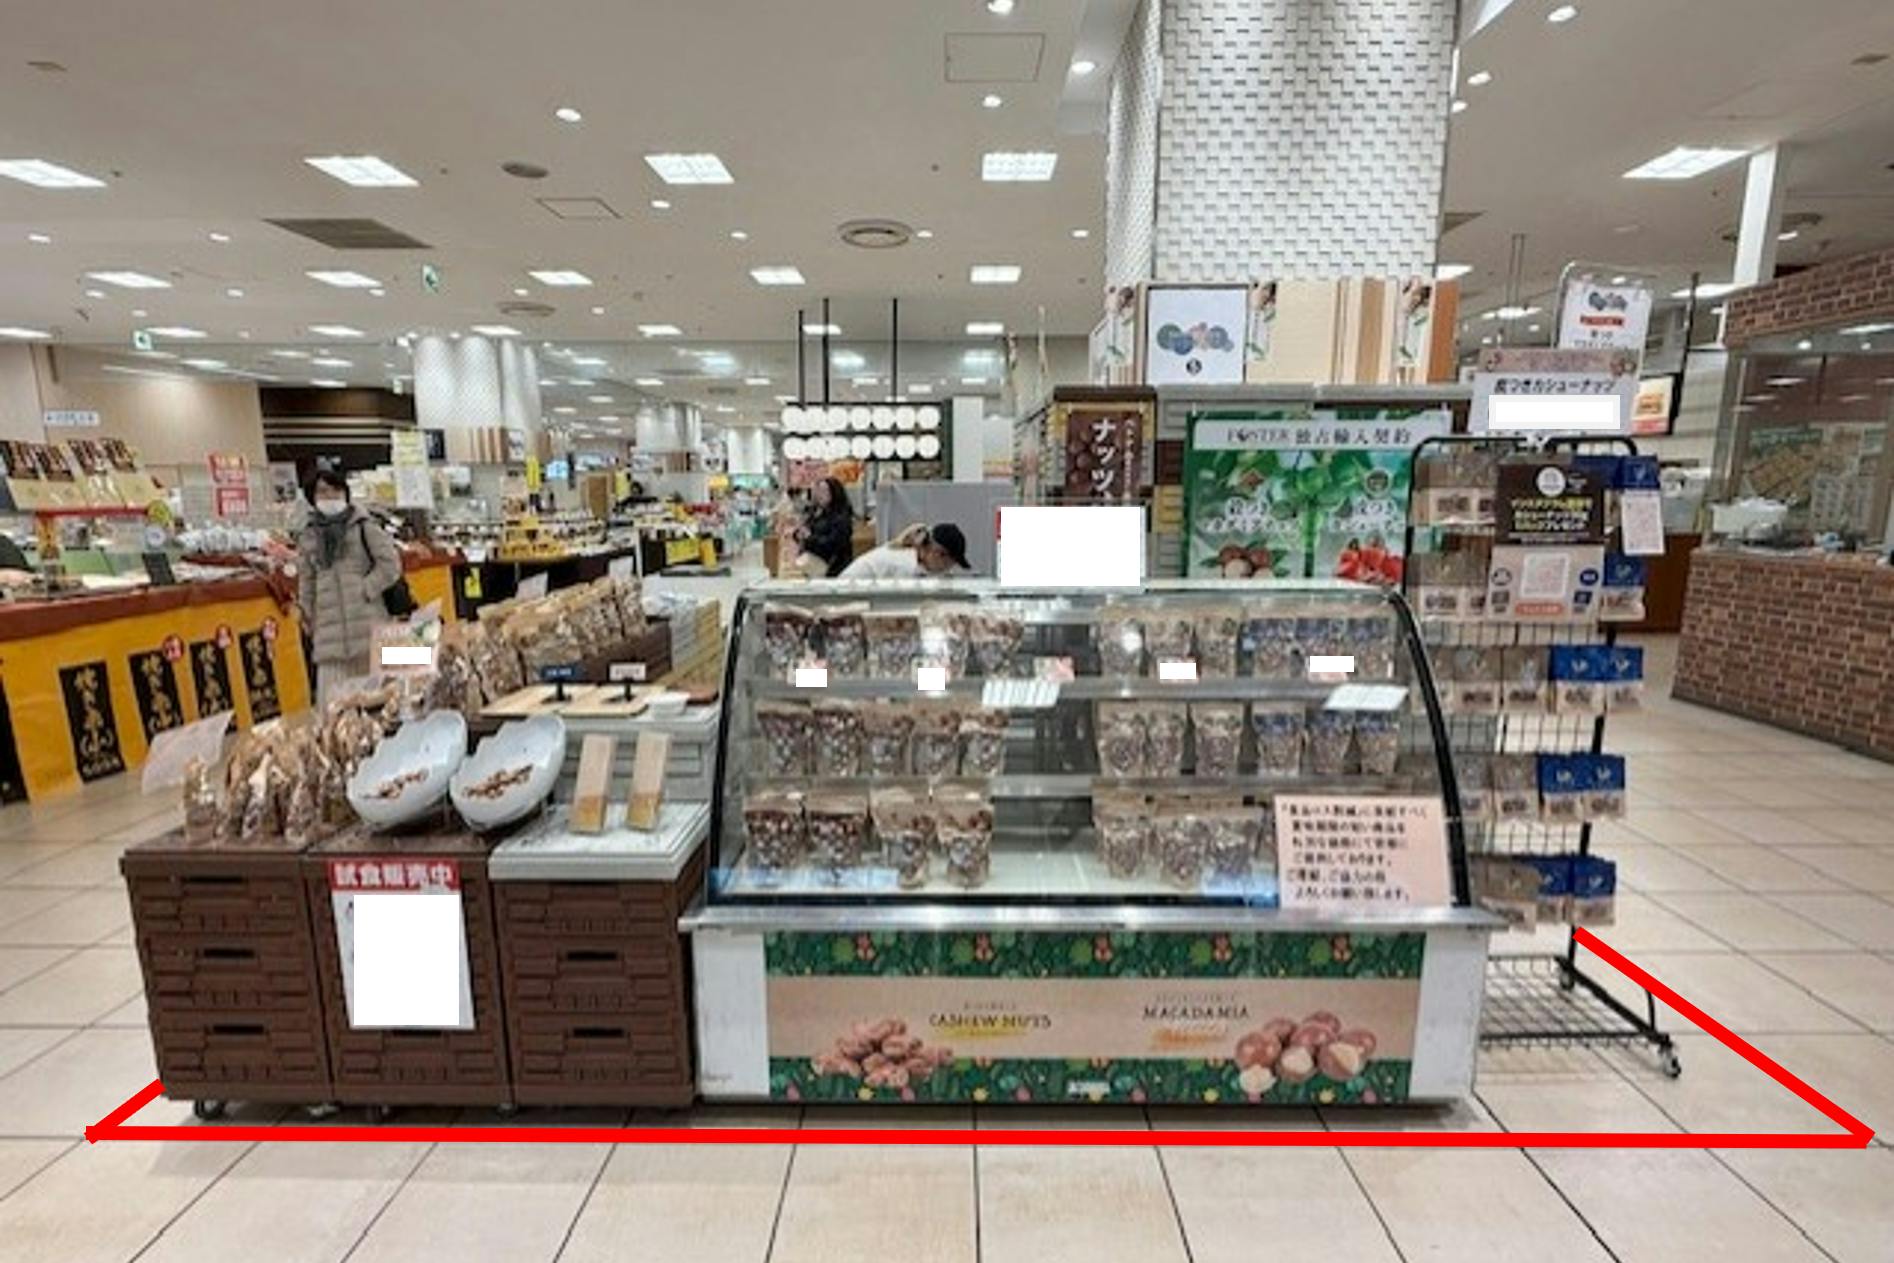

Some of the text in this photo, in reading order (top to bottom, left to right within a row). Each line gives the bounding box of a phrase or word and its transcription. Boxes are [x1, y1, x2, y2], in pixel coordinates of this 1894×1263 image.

[333, 862, 453, 886] 試食販売中
[928, 1013, 1051, 1029] CASHEW NUTS
[1143, 1005, 1250, 1021] MACADAMIA
